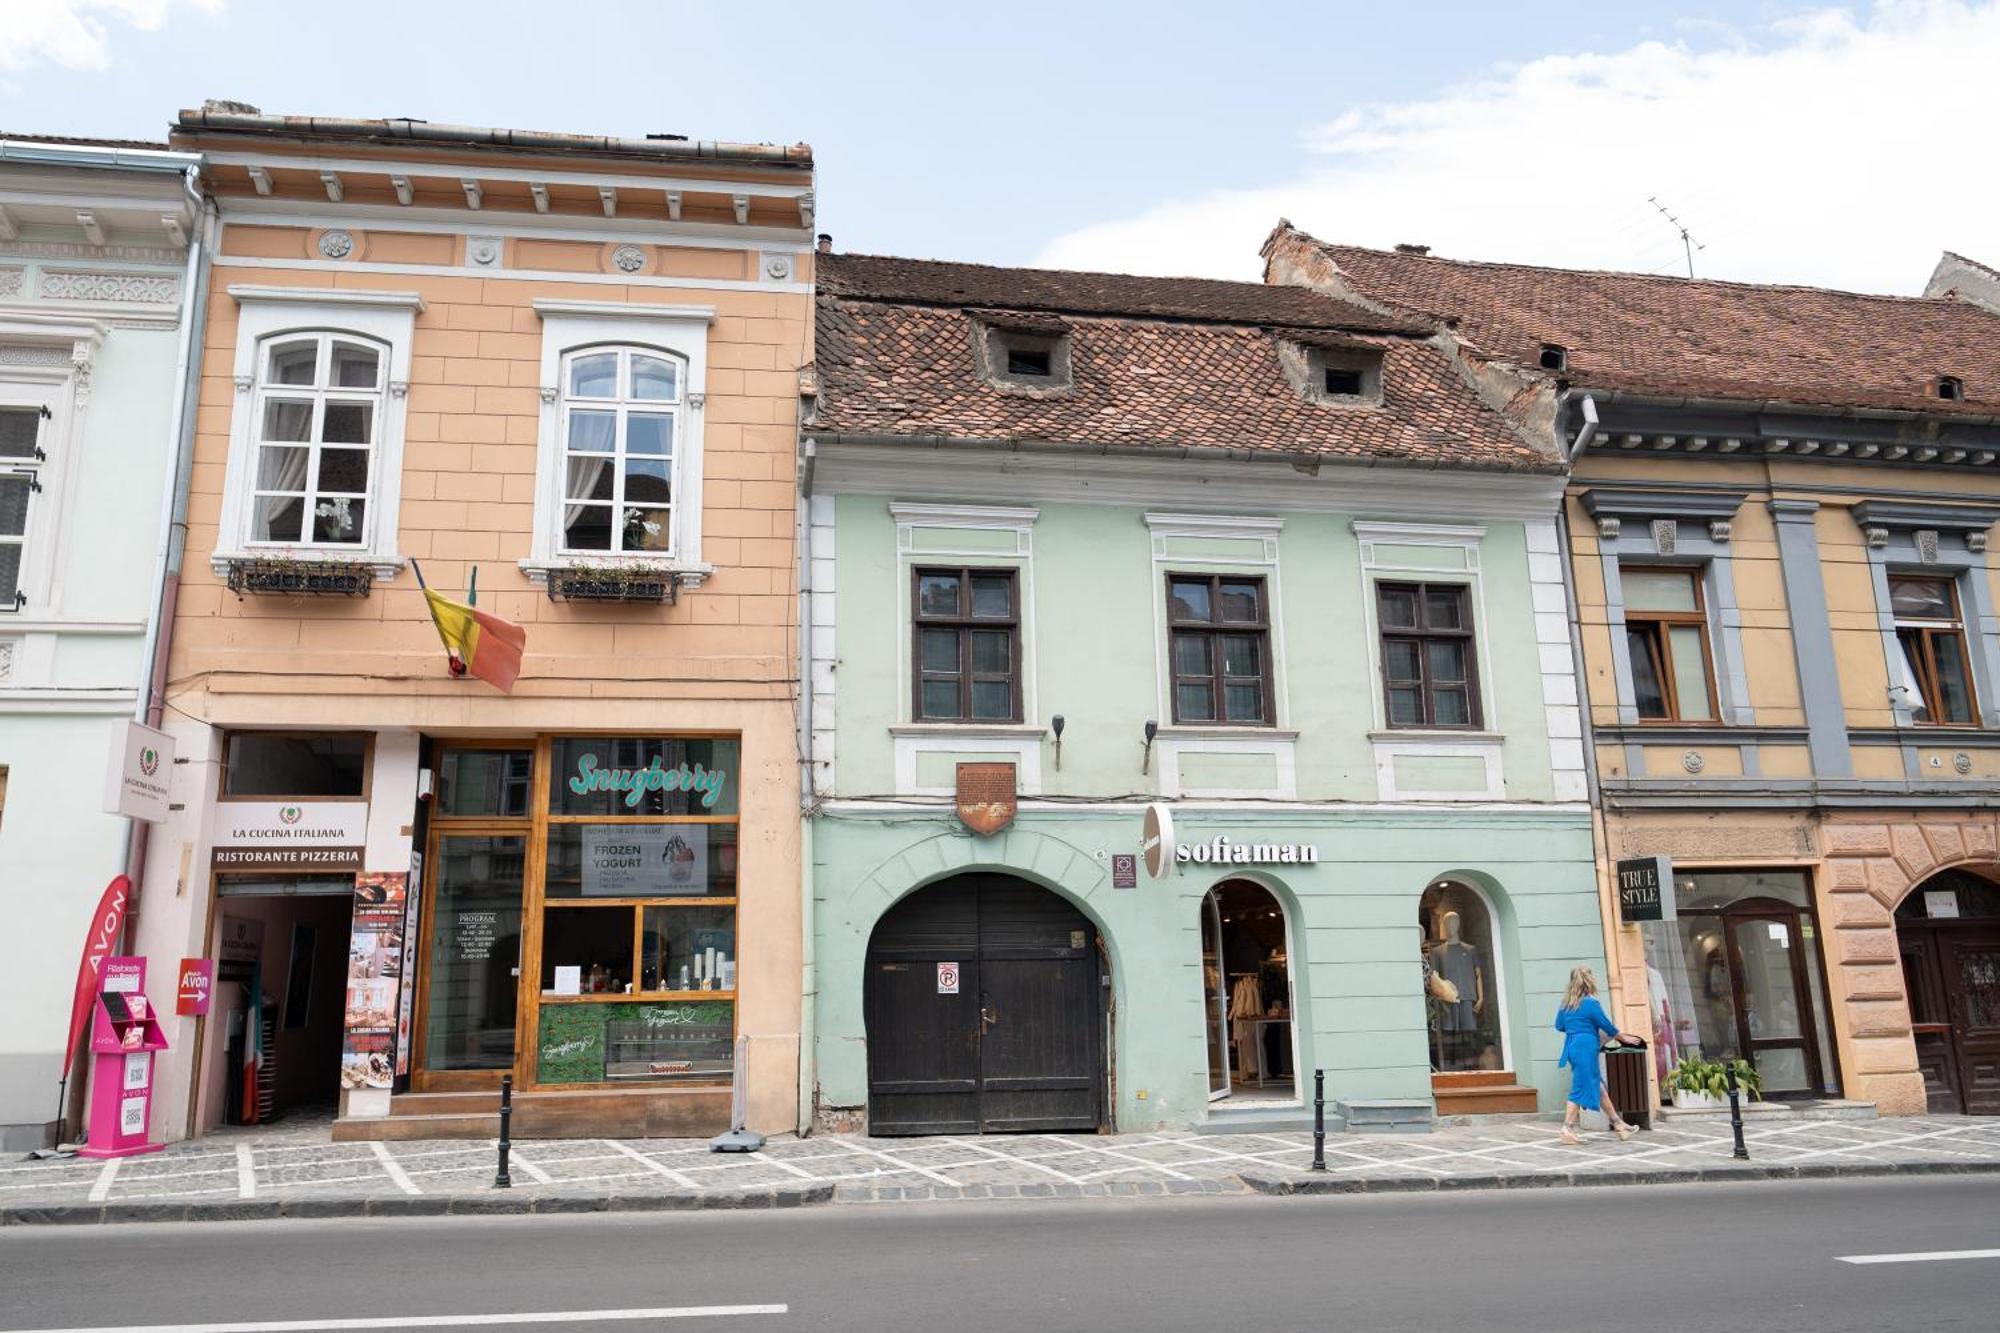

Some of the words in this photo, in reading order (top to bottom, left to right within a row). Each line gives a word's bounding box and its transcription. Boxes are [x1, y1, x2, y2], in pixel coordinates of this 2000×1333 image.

[569, 753, 725, 807] Snugberry
[232, 829, 246, 838] LA
[249, 829, 291, 838] CUCINA
[294, 828, 345, 838] ITALIANA
[594, 845, 641, 856] FROZEN
[1176, 834, 1318, 863] sofiaman
[216, 852, 297, 862] RISTORANTE
[300, 851, 359, 862] PIZZERIA
[592, 858, 641, 869] YOGURT
[1621, 868, 1656, 889] TRUE
[1622, 887, 1658, 905] STYLE
[459, 914, 496, 922] PROGRAM
[89, 890, 125, 975] AVON
[181, 971, 208, 989] Avon
[123, 1089, 149, 1097] AVON
